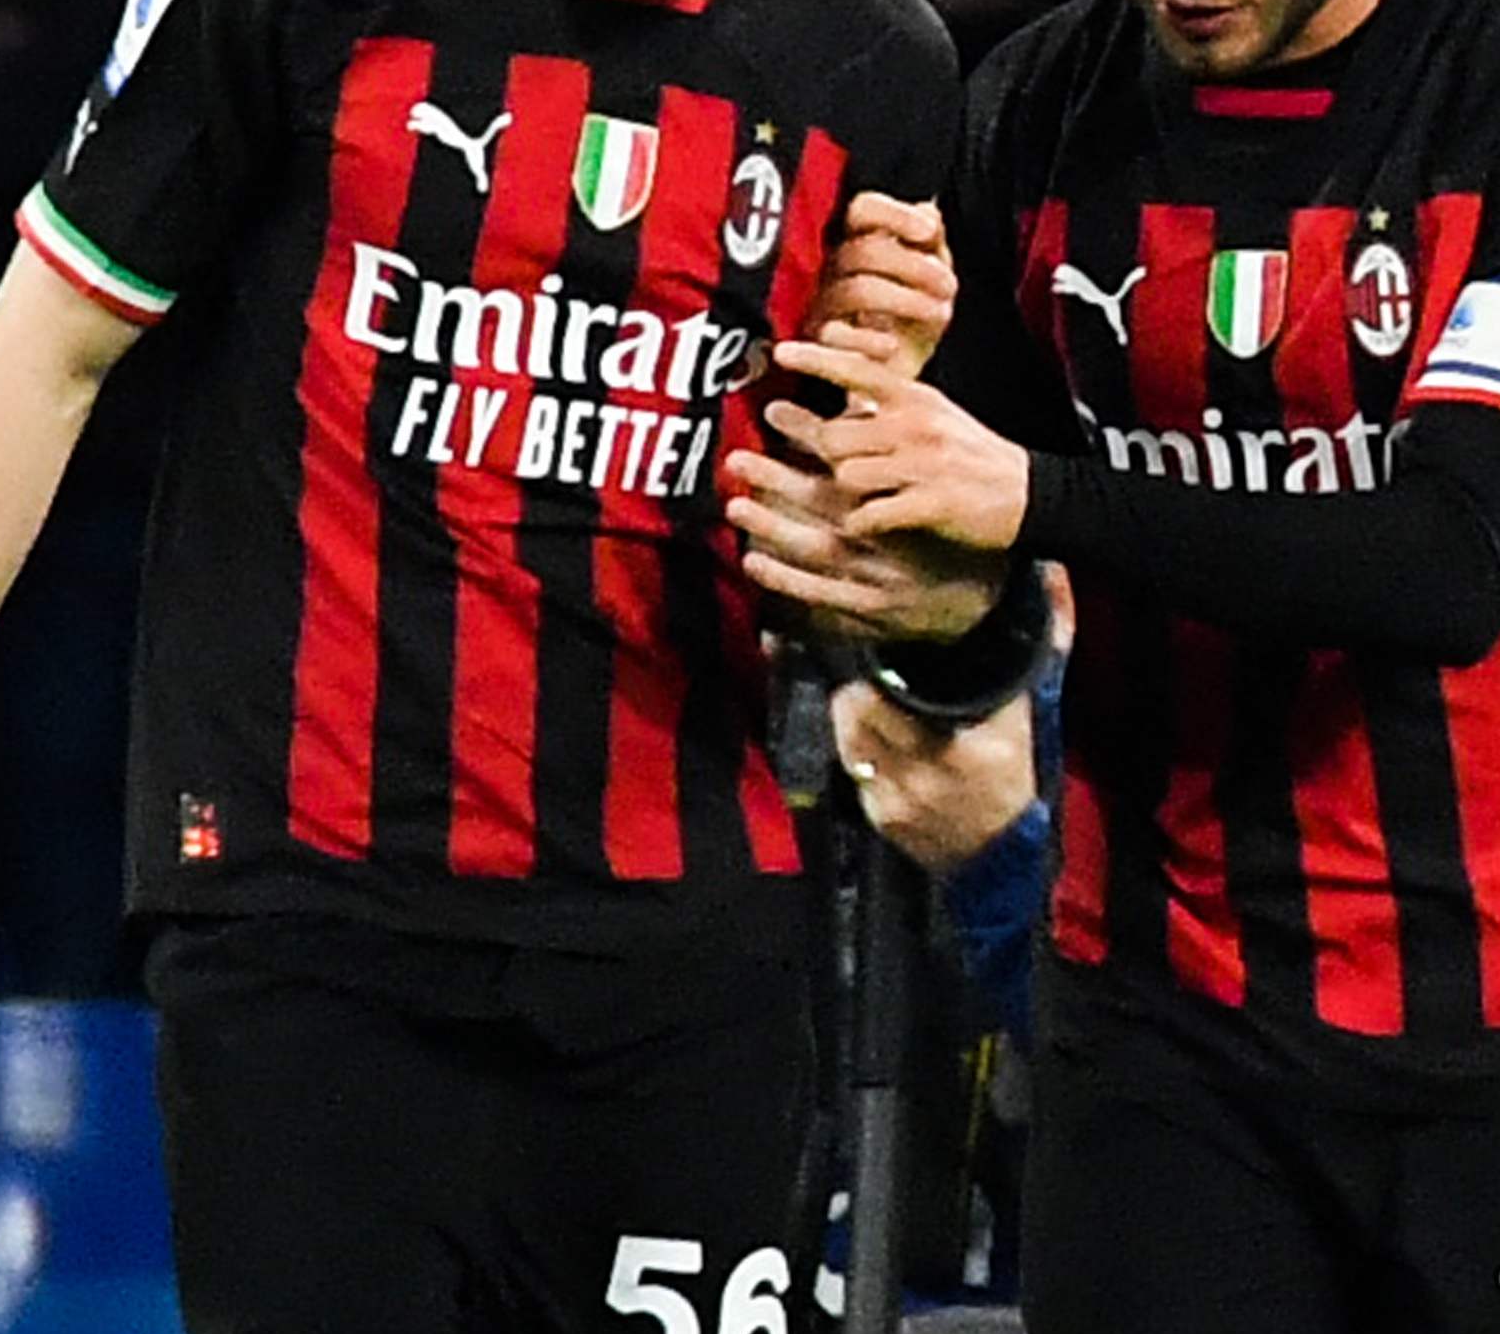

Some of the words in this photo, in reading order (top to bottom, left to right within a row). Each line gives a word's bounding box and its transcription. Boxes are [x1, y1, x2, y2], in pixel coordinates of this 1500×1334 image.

[343, 240, 774, 401] Emirates
[390, 375, 508, 467] FLY
[515, 394, 713, 498] BETTER
[1072, 397, 1412, 494] mirat
